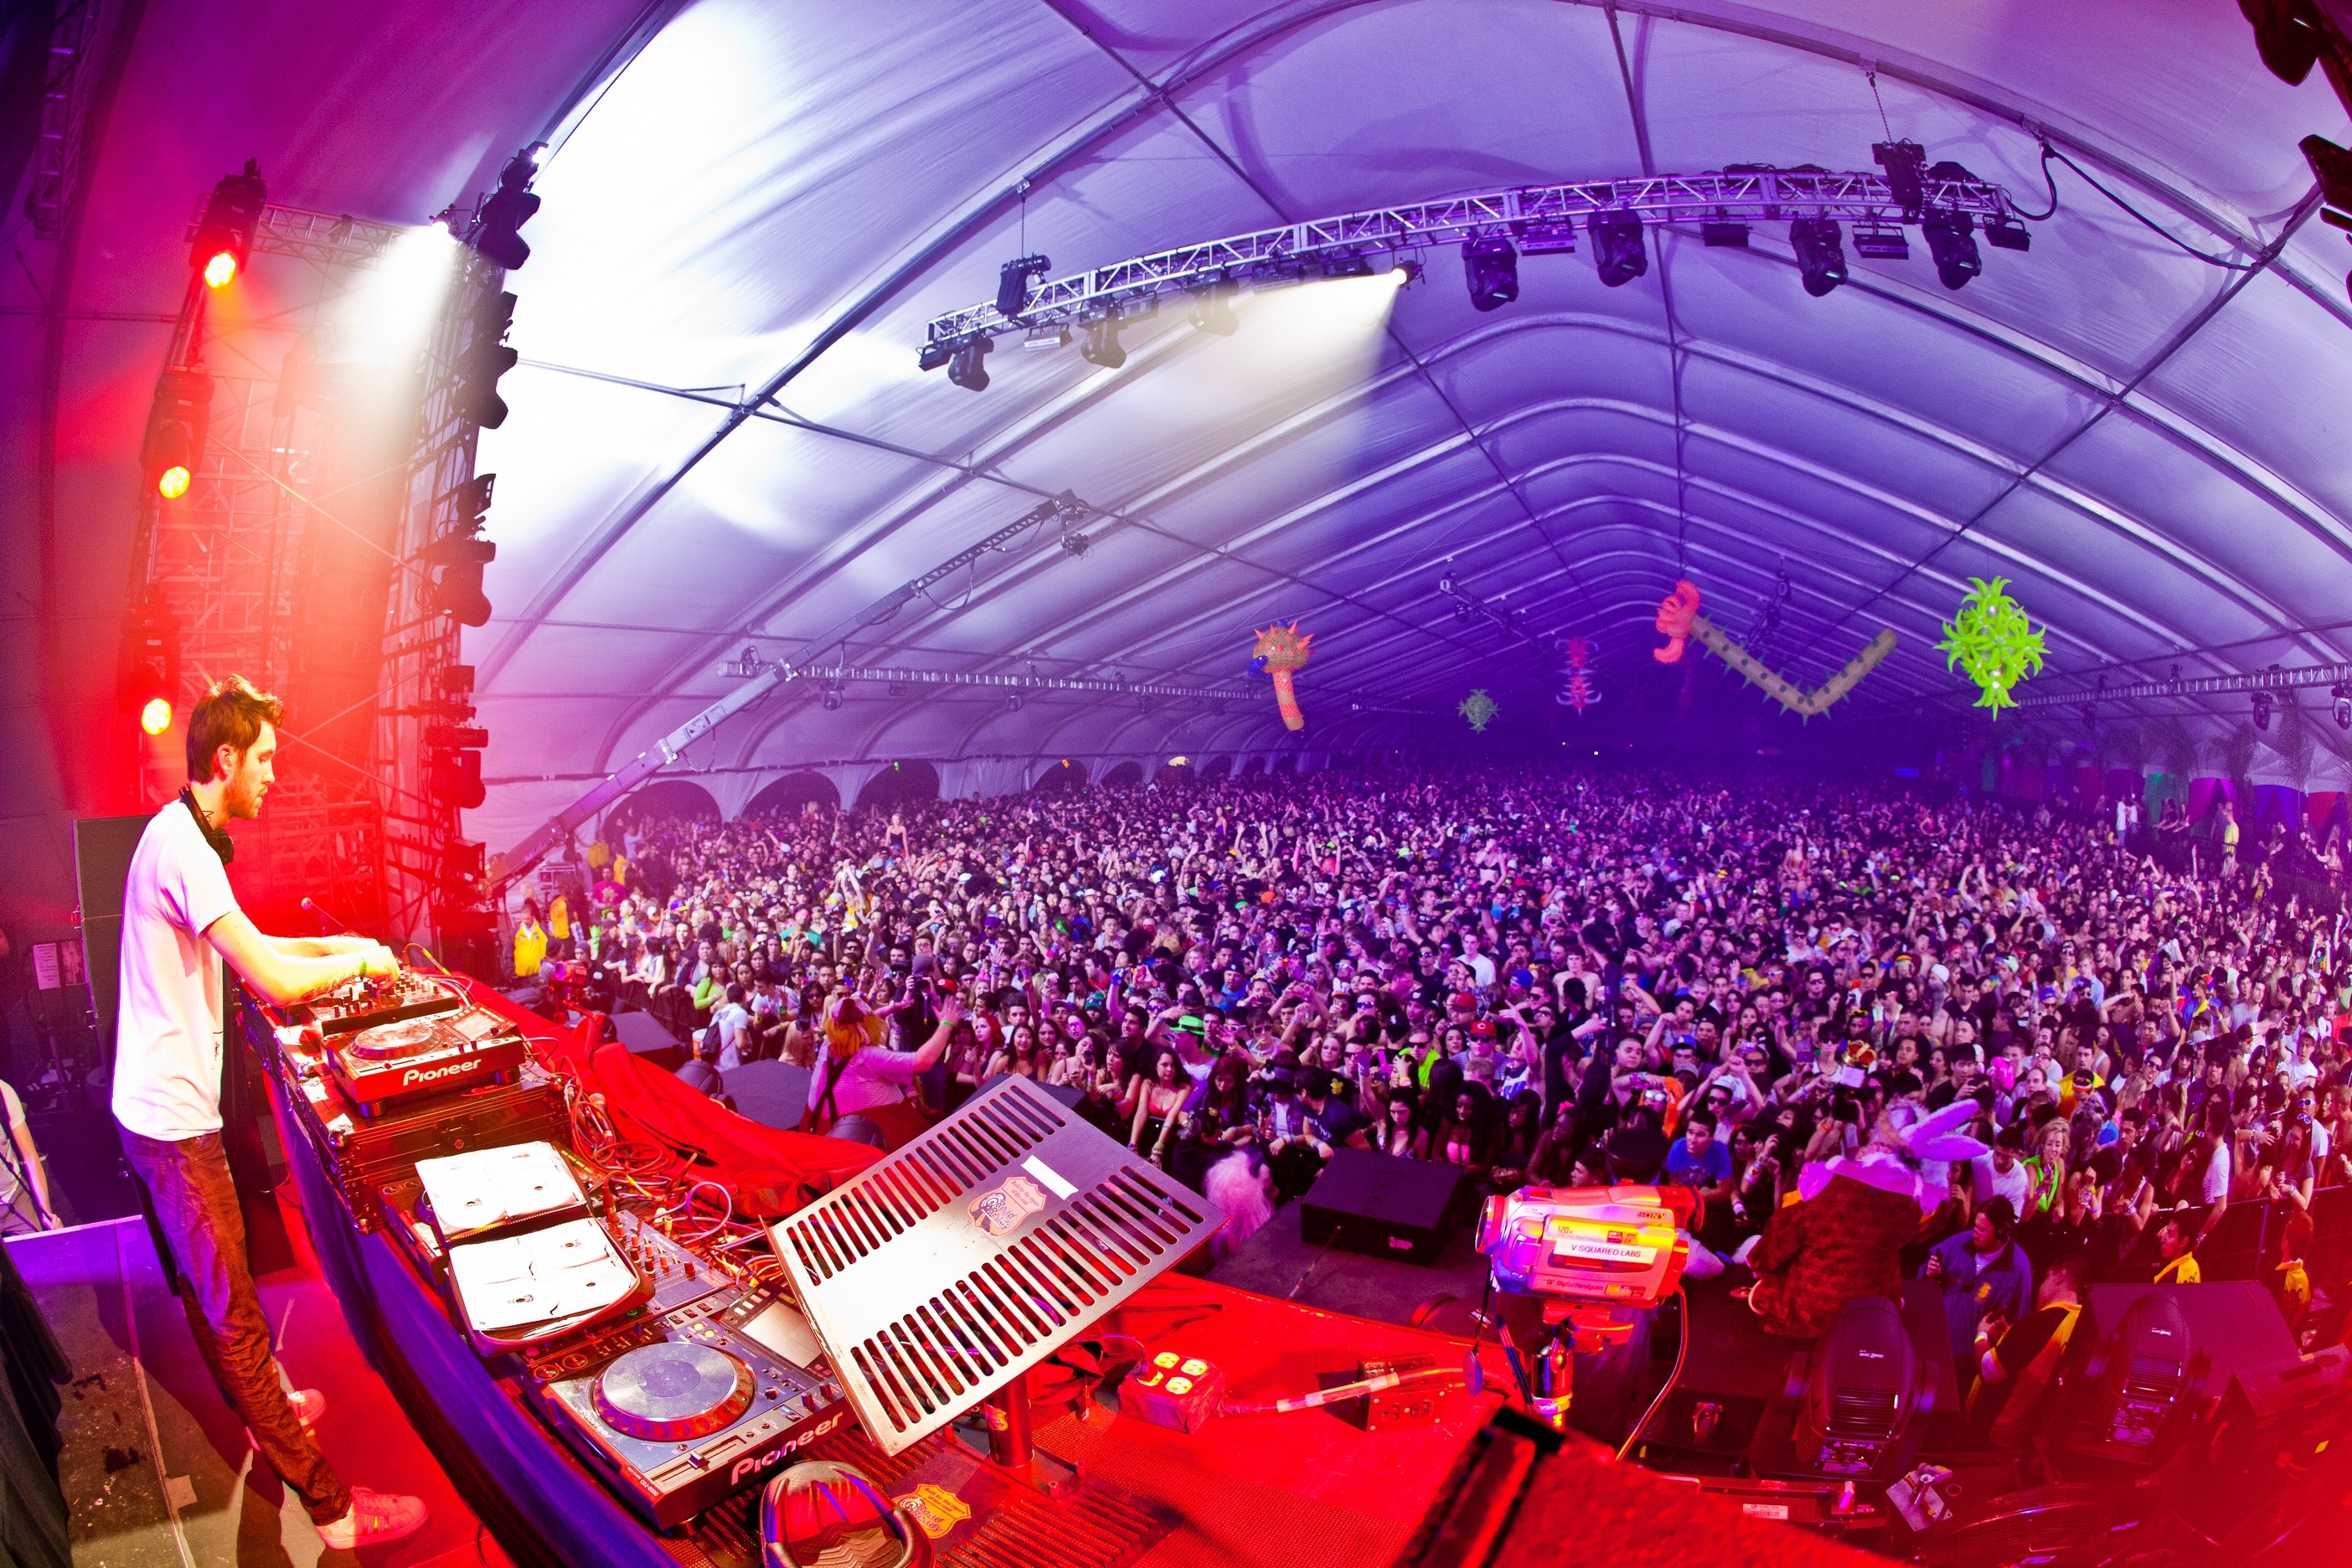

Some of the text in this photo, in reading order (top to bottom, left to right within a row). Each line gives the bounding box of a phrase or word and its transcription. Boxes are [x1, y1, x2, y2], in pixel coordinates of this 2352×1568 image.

[403, 1059, 482, 1086] Pioneer
[1011, 1180, 1019, 1189] Built
[988, 1206, 1012, 1229] Ready
[996, 1199, 1018, 1220] Road
[1578, 1245, 1619, 1256] SQUARED
[731, 1411, 843, 1486] Pioneer
[924, 1487, 936, 1496] Built
[951, 1504, 966, 1514] rigors
[933, 1498, 941, 1506] the
[940, 1504, 953, 1512] road
[917, 1504, 945, 1523] Road
